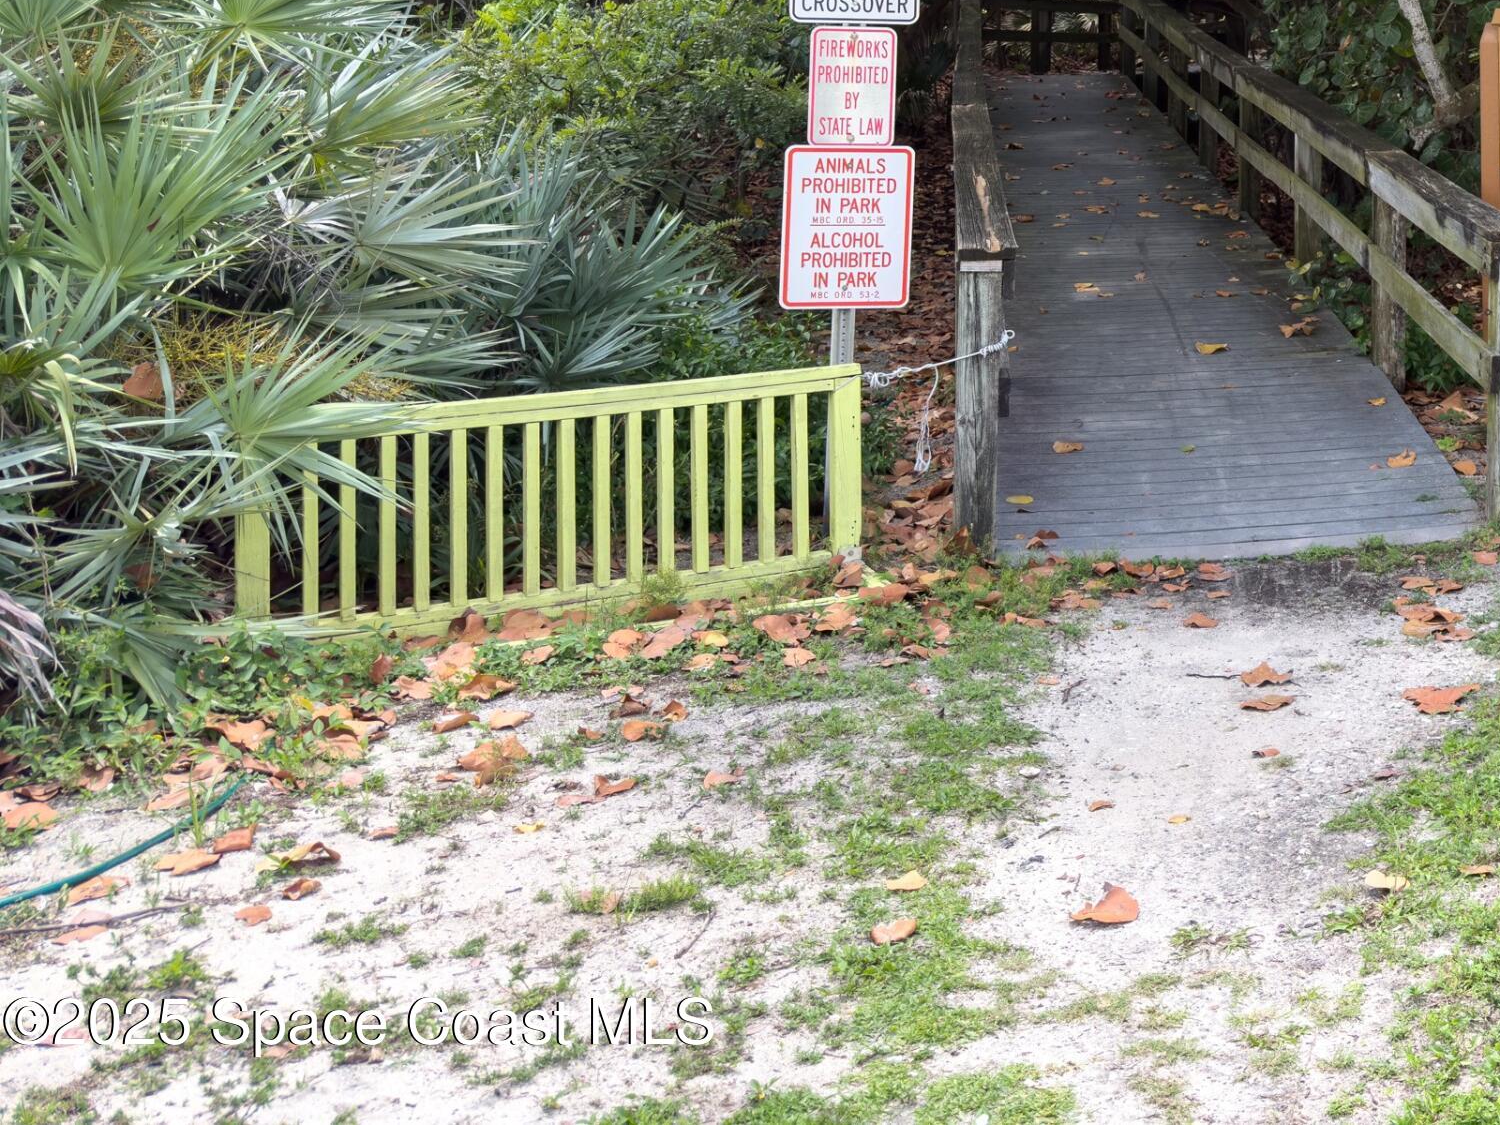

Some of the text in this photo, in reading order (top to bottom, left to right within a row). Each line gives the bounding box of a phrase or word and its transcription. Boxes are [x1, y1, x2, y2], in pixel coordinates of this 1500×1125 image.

[819, 40, 888, 59] FIREWORKS
[818, 65, 888, 84] PROHIBITED
[845, 92, 860, 109] BY
[819, 117, 884, 135] STATE LAW
[815, 158, 886, 174] ANIMALS
[802, 177, 897, 194] PROHIBITED
[816, 197, 881, 213] IN PARK
[810, 233, 884, 248] ALCOHOL
[800, 252, 892, 268] PROHIBITED
[814, 271, 877, 288] IN PARK
[860, 291, 880, 299] 53-2
